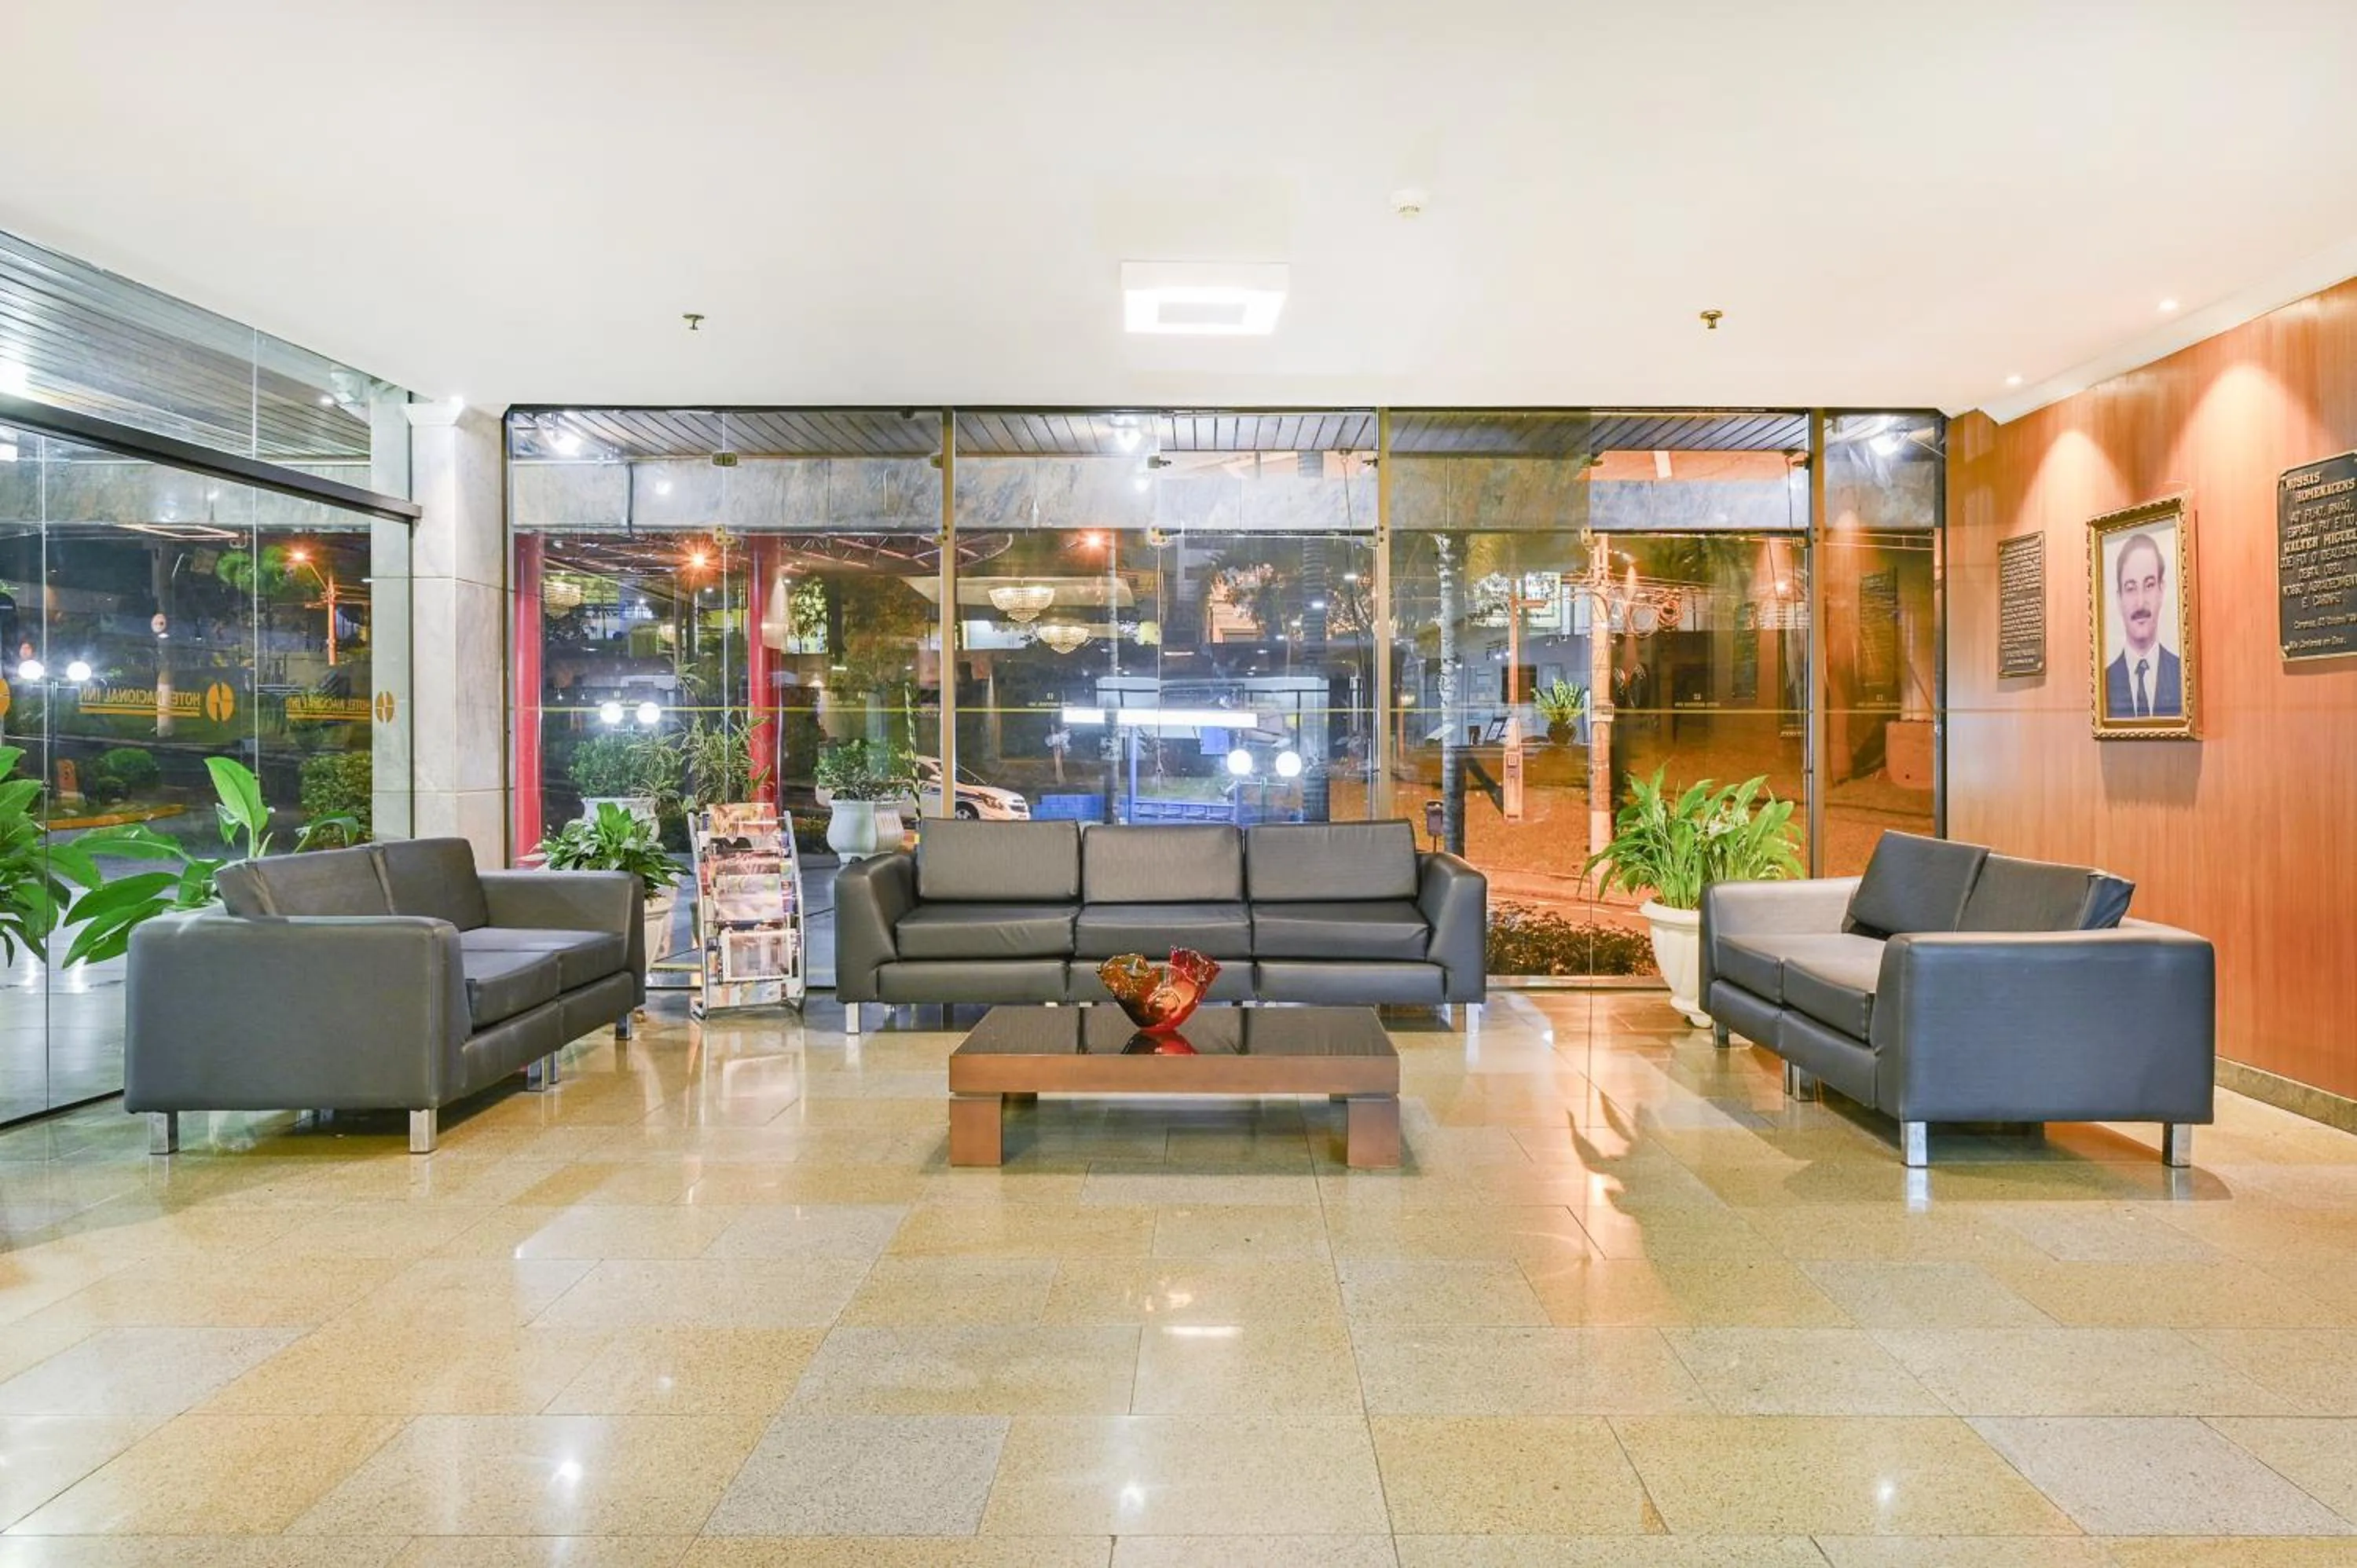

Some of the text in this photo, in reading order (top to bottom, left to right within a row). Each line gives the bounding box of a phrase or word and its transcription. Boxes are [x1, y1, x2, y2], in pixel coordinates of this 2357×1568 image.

[2286, 471, 2320, 491] NOSSAS
[2296, 478, 2355, 503] HOMENAGENS
[2335, 516, 2341, 529] E
[2284, 536, 2319, 555] WALTER
[2311, 551, 2318, 564] O
[2301, 596, 2309, 609] E
